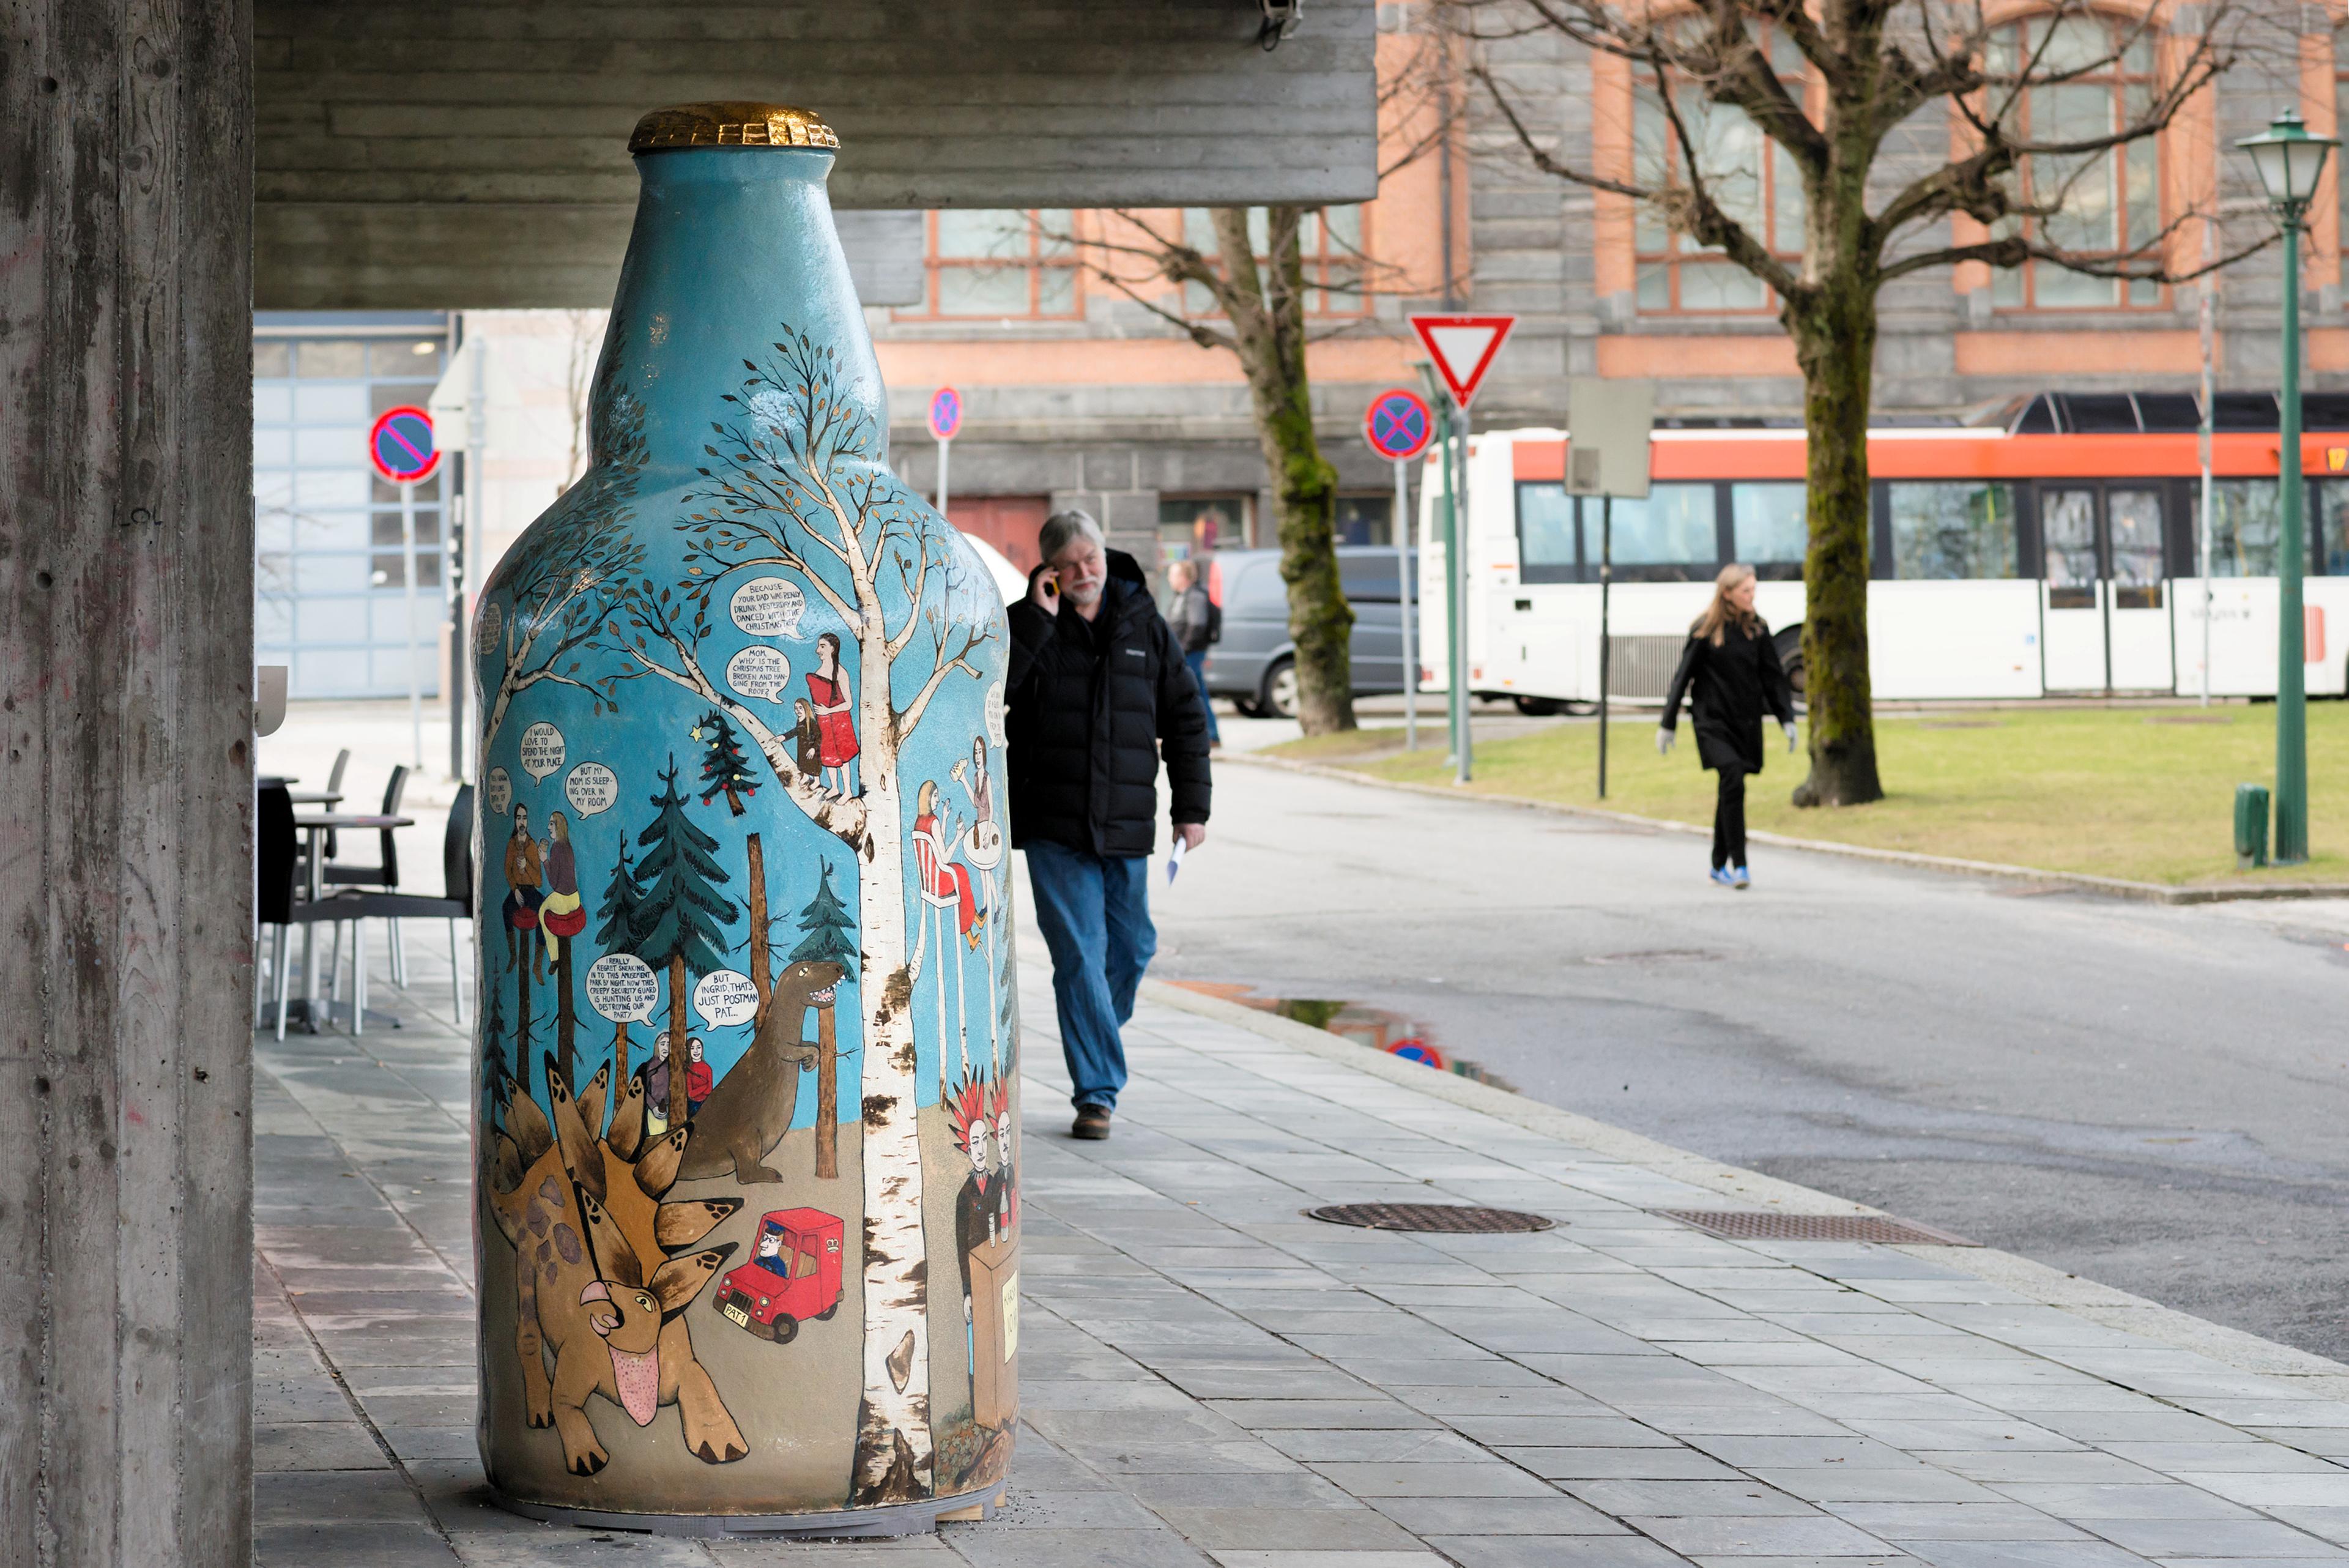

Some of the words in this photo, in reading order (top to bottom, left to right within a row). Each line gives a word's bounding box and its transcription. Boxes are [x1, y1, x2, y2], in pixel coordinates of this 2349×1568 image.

[749, 583, 783, 593] BECAUSE
[734, 604, 757, 614] DRUNK
[759, 601, 790, 610] YESTERDAY
[737, 614, 764, 623] DANCED
[748, 688, 770, 697] ROOF?
[522, 748, 538, 756] SPEND
[538, 747, 548, 756] THE
[550, 746, 565, 755] NIGHT
[532, 759, 546, 768] YOUR
[581, 767, 592, 776] BUT
[588, 797, 607, 807] ROOM
[714, 974, 729, 984] BUT
[701, 984, 730, 994] INGRID,
[730, 981, 752, 991] THAT'S
[699, 995, 719, 1006] JUST
[724, 993, 758, 1005] POSTMAN
[726, 1306, 741, 1320] PAT
[741, 1315, 746, 1323] 1
